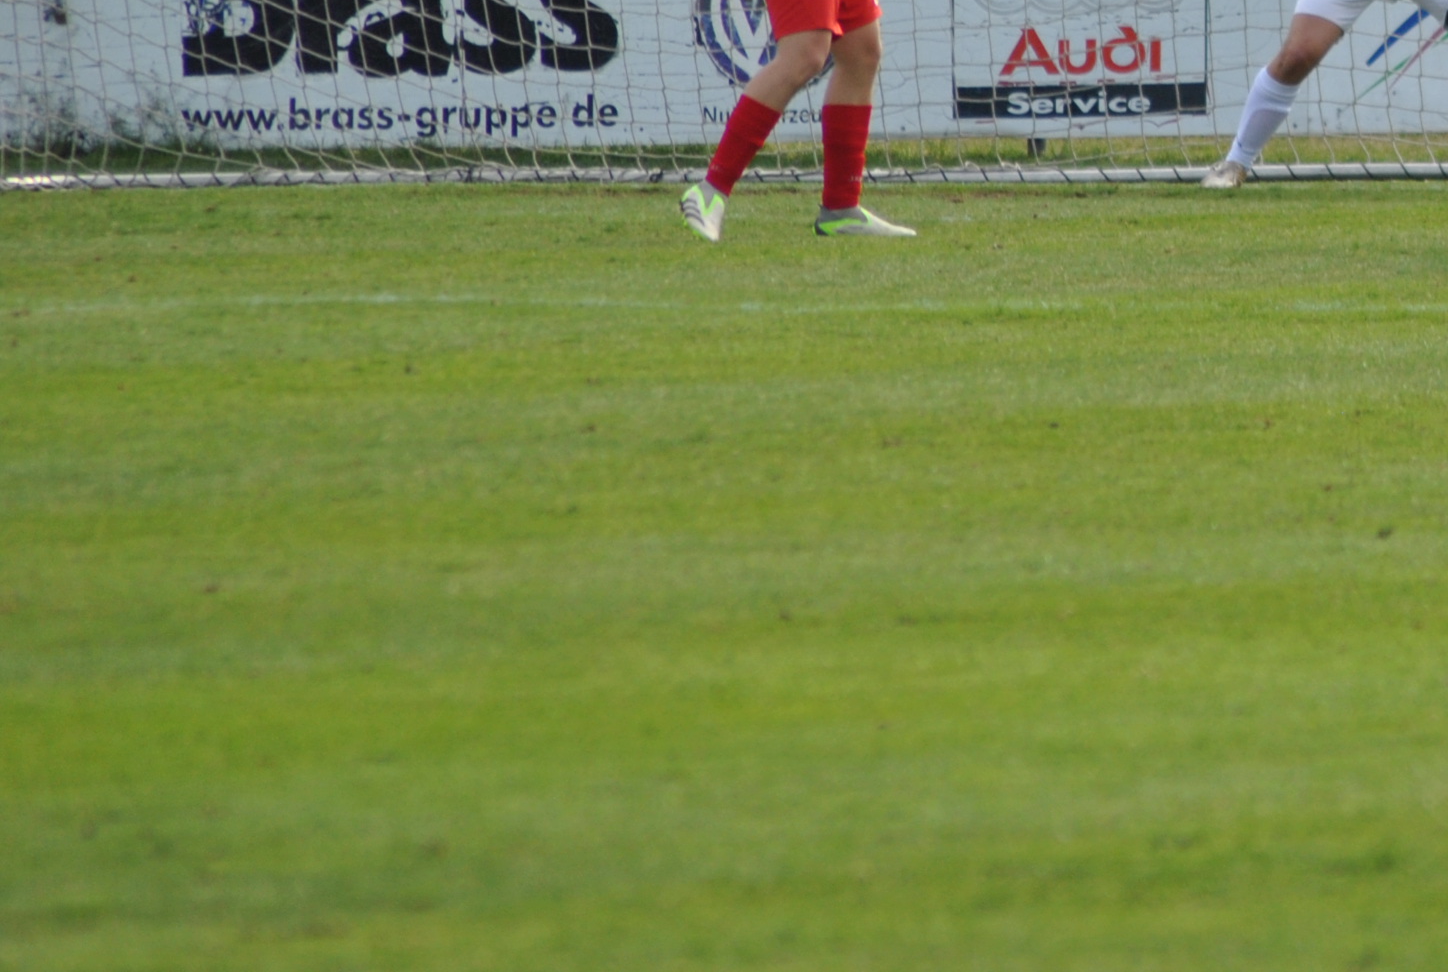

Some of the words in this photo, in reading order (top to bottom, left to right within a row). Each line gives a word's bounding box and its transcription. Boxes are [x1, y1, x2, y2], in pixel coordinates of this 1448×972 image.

[999, 25, 1162, 76] Audi
[181, 93, 619, 137] www.brass-gruppede
[1006, 90, 1151, 115] Service
